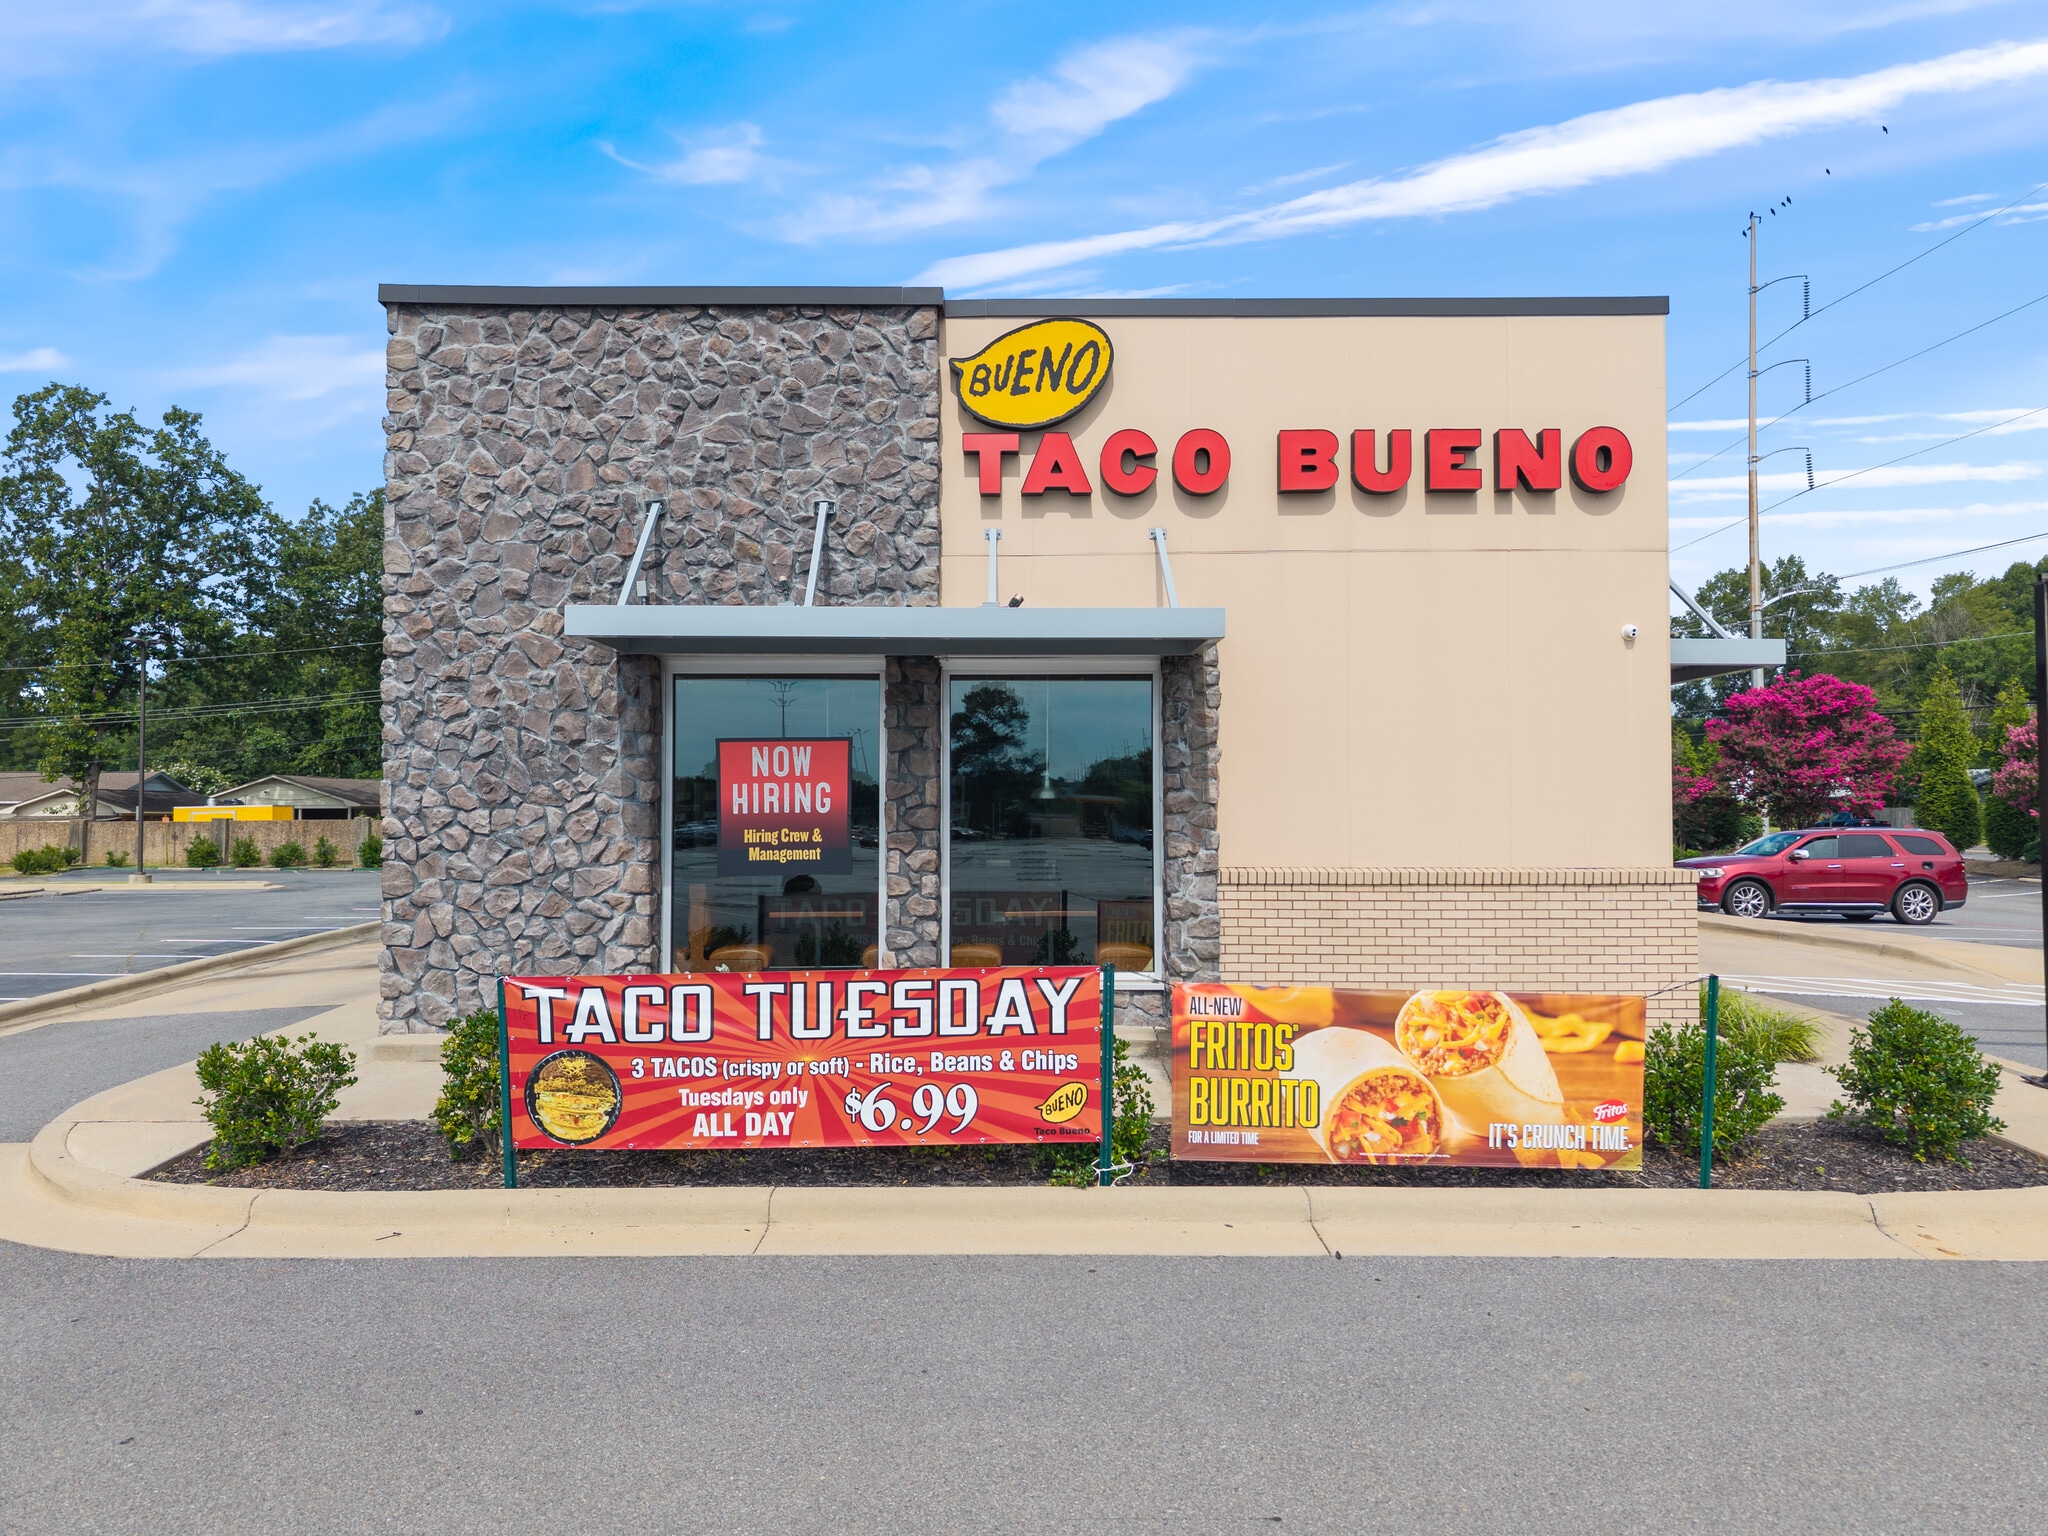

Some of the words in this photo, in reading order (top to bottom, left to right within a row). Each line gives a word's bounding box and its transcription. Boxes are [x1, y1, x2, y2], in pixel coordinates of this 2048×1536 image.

[969, 340, 1100, 397] BUENO
[962, 428, 1231, 497] TACO
[1277, 426, 1633, 497] BUENO
[751, 746, 812, 777] NOW
[732, 782, 831, 814] HIRING
[744, 829, 778, 846] Hiring
[781, 828, 809, 843] Crew
[812, 828, 822, 843] &
[748, 847, 821, 863] Management
[522, 984, 713, 1044] TACO
[743, 977, 1084, 1040] TUESDAY
[1189, 996, 1242, 1016] ALL-NEW
[631, 1057, 645, 1078] 3
[650, 1056, 718, 1078] TACOS
[722, 1059, 782, 1080] (crispy
[786, 1061, 805, 1076] or
[809, 1056, 850, 1078] soft)
[869, 1052, 924, 1076] Rice,
[929, 1051, 993, 1072] Beans
[998, 1049, 1015, 1071] &
[1020, 1049, 1078, 1075] Chips
[678, 1088, 764, 1109] Tuesdays
[769, 1086, 808, 1108] only
[844, 1081, 979, 1135] $6.99
[1045, 1087, 1083, 1115] BUENO
[1189, 1076, 1320, 1128] BURRITO
[1592, 1102, 1629, 1121] Fritos
[692, 1113, 738, 1137] ALL
[745, 1111, 795, 1136] DAY
[1034, 1127, 1057, 1136] Taco
[1059, 1127, 1091, 1136] Bueno
[1188, 1130, 1202, 1144] FOR
[1203, 1130, 1209, 1144] A
[1210, 1130, 1239, 1145] LIMITED
[1241, 1131, 1259, 1145] TIME
[1522, 1123, 1586, 1150] CRUNCH
[1590, 1125, 1634, 1152] TIME.
